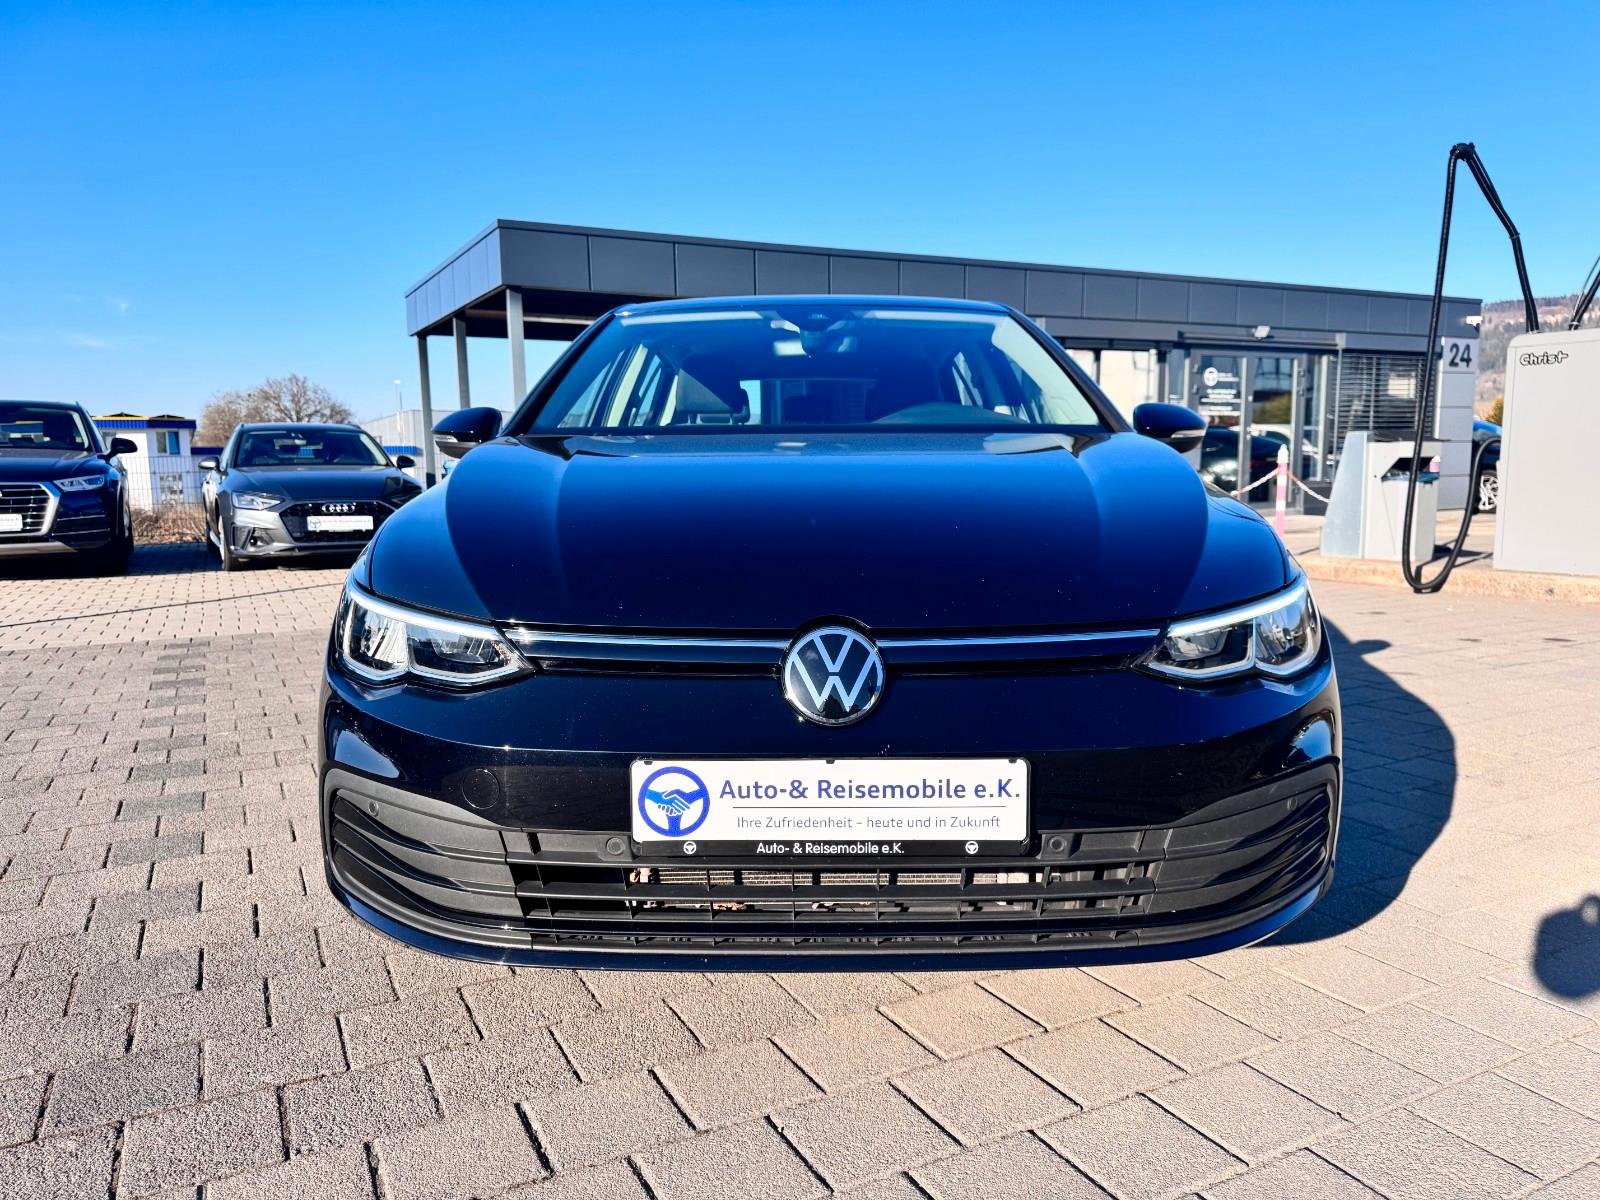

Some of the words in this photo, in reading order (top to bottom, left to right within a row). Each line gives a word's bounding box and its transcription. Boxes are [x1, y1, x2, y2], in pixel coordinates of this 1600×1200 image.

[1448, 343, 1472, 368] 24
[1519, 350, 1569, 367] Christ
[817, 778, 967, 799] Reisemobile
[973, 778, 1021, 799] e.K.
[737, 816, 762, 829] Ihre
[765, 816, 853, 829] Zufriedenheit
[866, 816, 903, 829] heute
[907, 816, 931, 829] und
[935, 816, 947, 828] in
[950, 815, 1001, 829] Zukunft
[756, 842, 790, 854] Auto-
[793, 842, 803, 854] &
[805, 842, 880, 854] Reisemobile
[881, 842, 905, 854] e.K.
